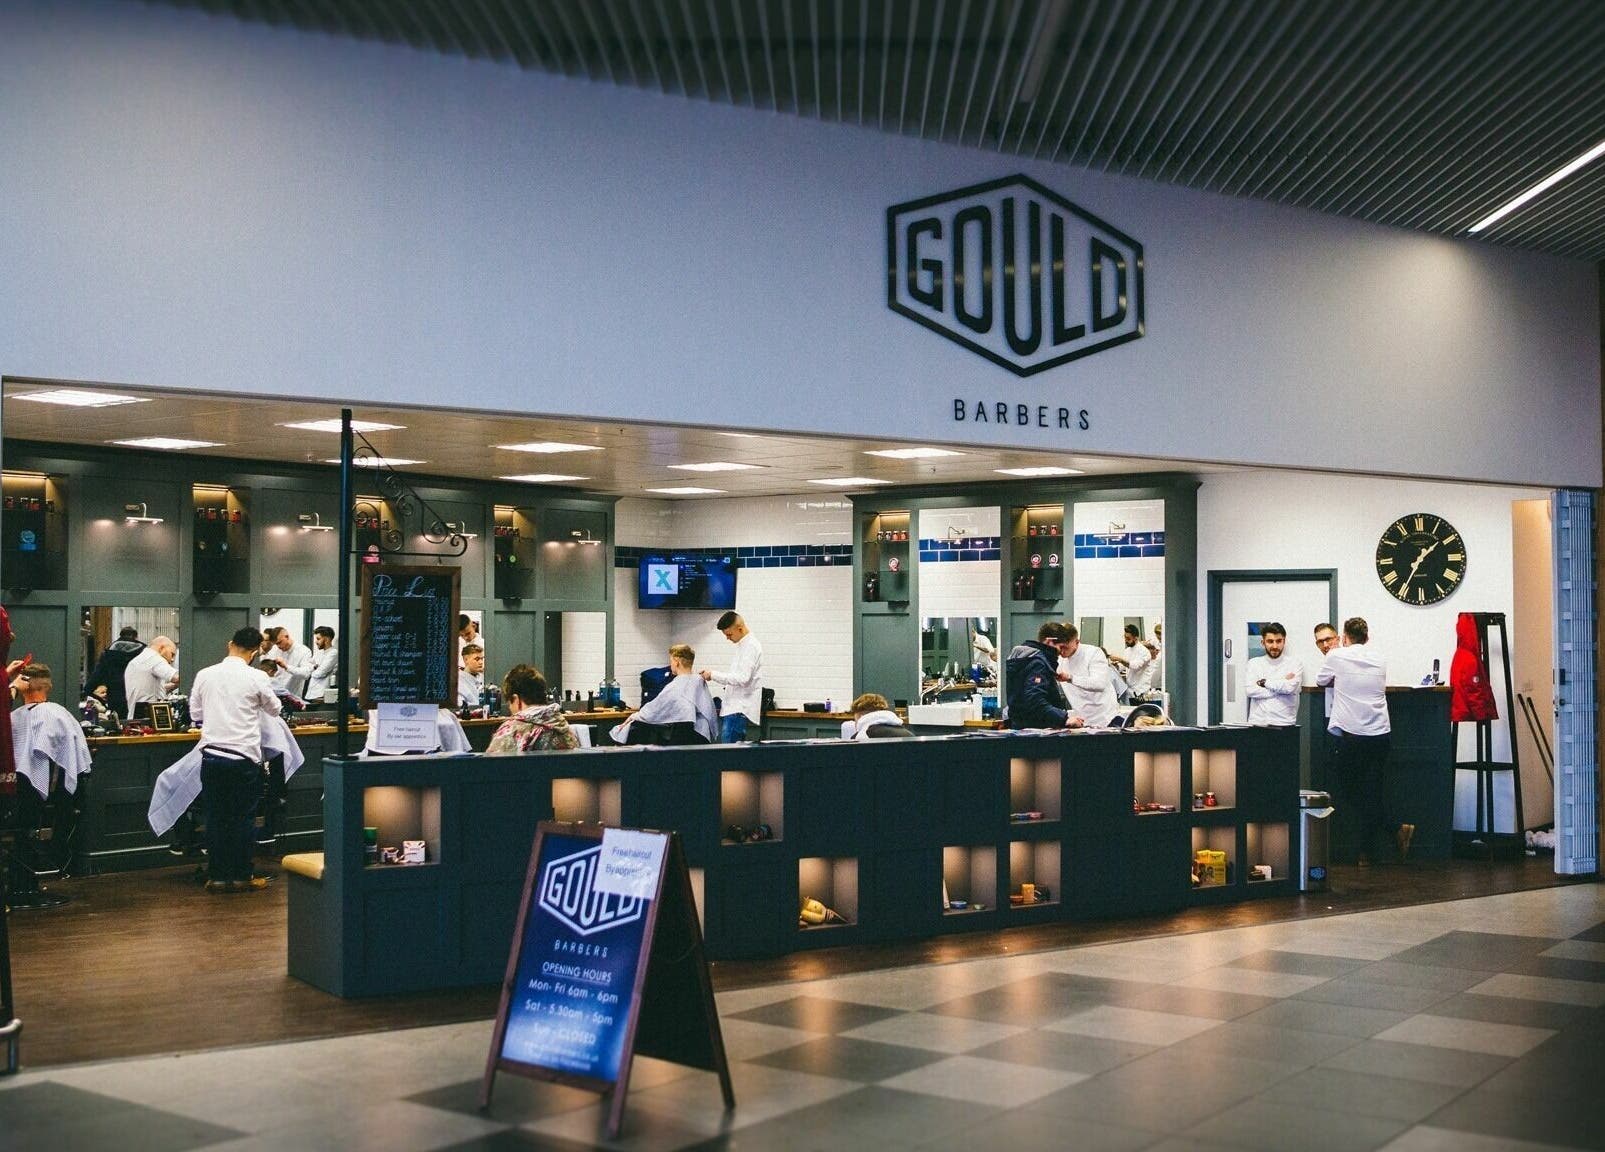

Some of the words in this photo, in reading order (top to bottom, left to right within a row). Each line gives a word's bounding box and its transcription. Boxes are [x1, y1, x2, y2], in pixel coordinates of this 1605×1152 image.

[906, 196, 1127, 357] GOULD
[953, 398, 1090, 431] BARBERS
[554, 939, 609, 958] BARBERS
[542, 961, 581, 977] OPENING
[582, 968, 612, 983] HOURS
[554, 982, 566, 994] Fri
[568, 985, 589, 999] 6am
[597, 990, 619, 1004] 6pm
[525, 998, 541, 1012] Sat
